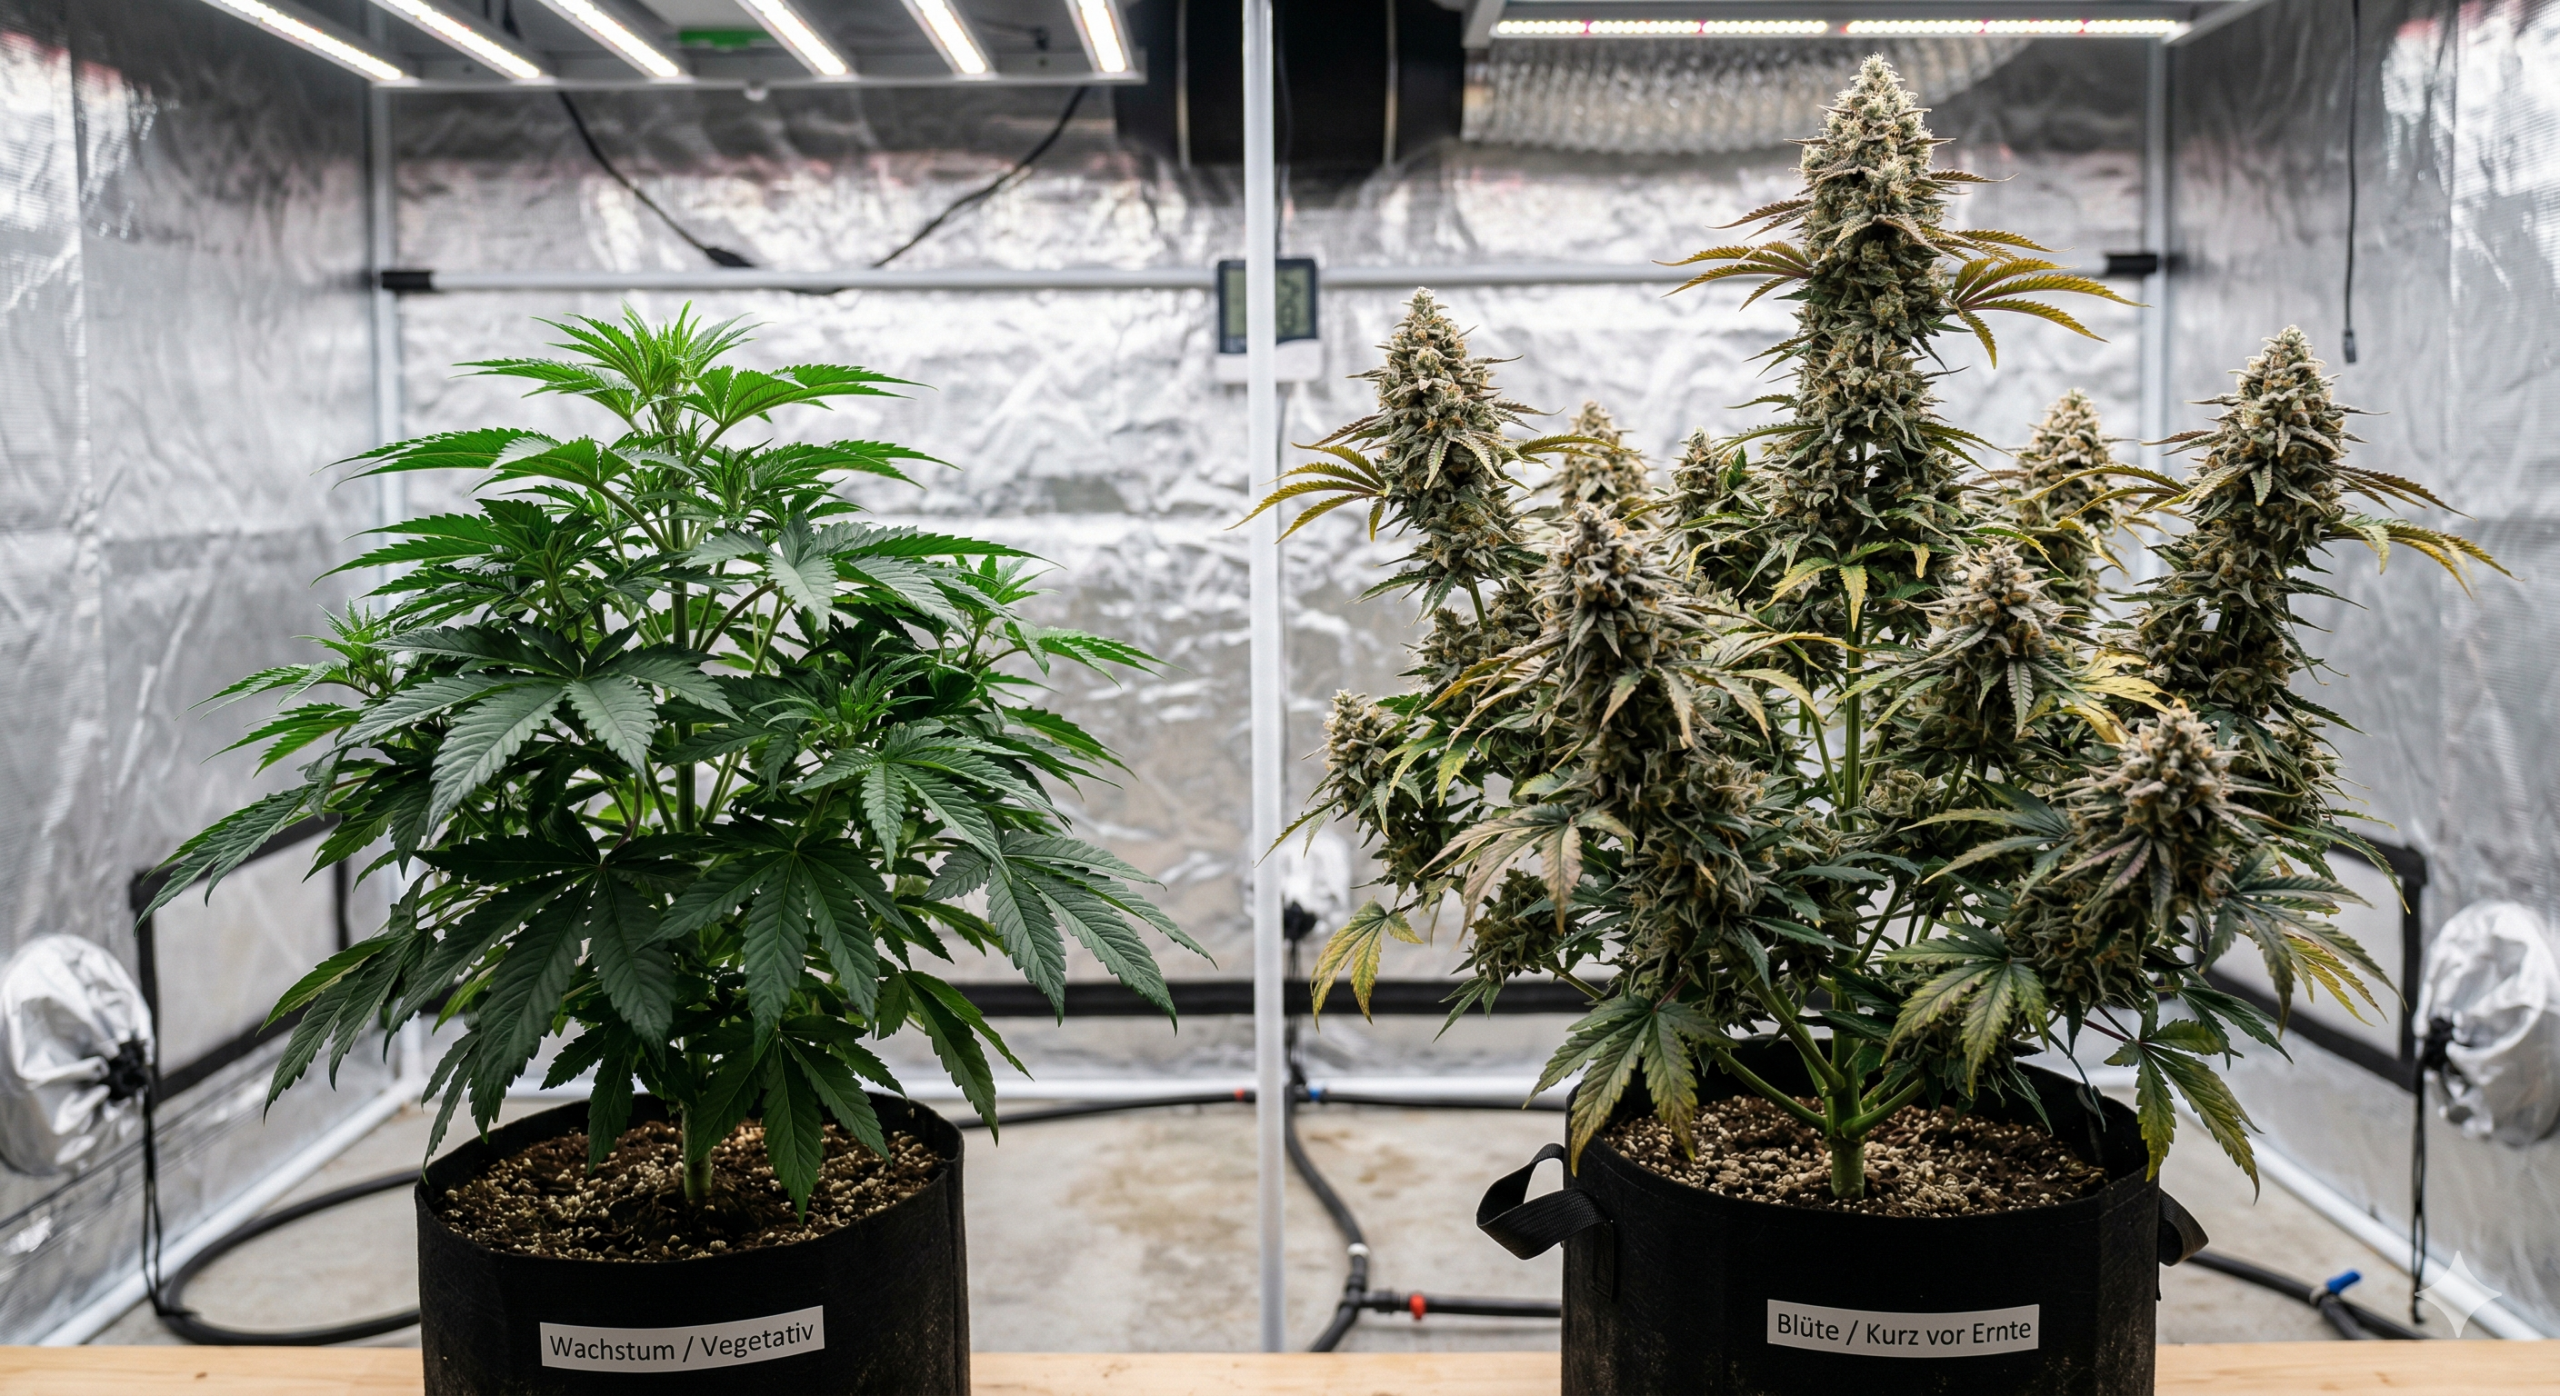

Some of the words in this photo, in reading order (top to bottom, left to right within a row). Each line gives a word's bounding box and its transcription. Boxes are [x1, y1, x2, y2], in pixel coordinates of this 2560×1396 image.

[549, 1335, 675, 1361] Wachstum
[682, 1336, 694, 1363] /
[700, 1322, 814, 1358] Vegetativ
[1777, 1313, 1839, 1341] Blüte
[1846, 1320, 1859, 1346] /
[1866, 1323, 1919, 1345] Kurz
[1926, 1328, 1965, 1345] vor
[1973, 1320, 2032, 1343] Ernte
